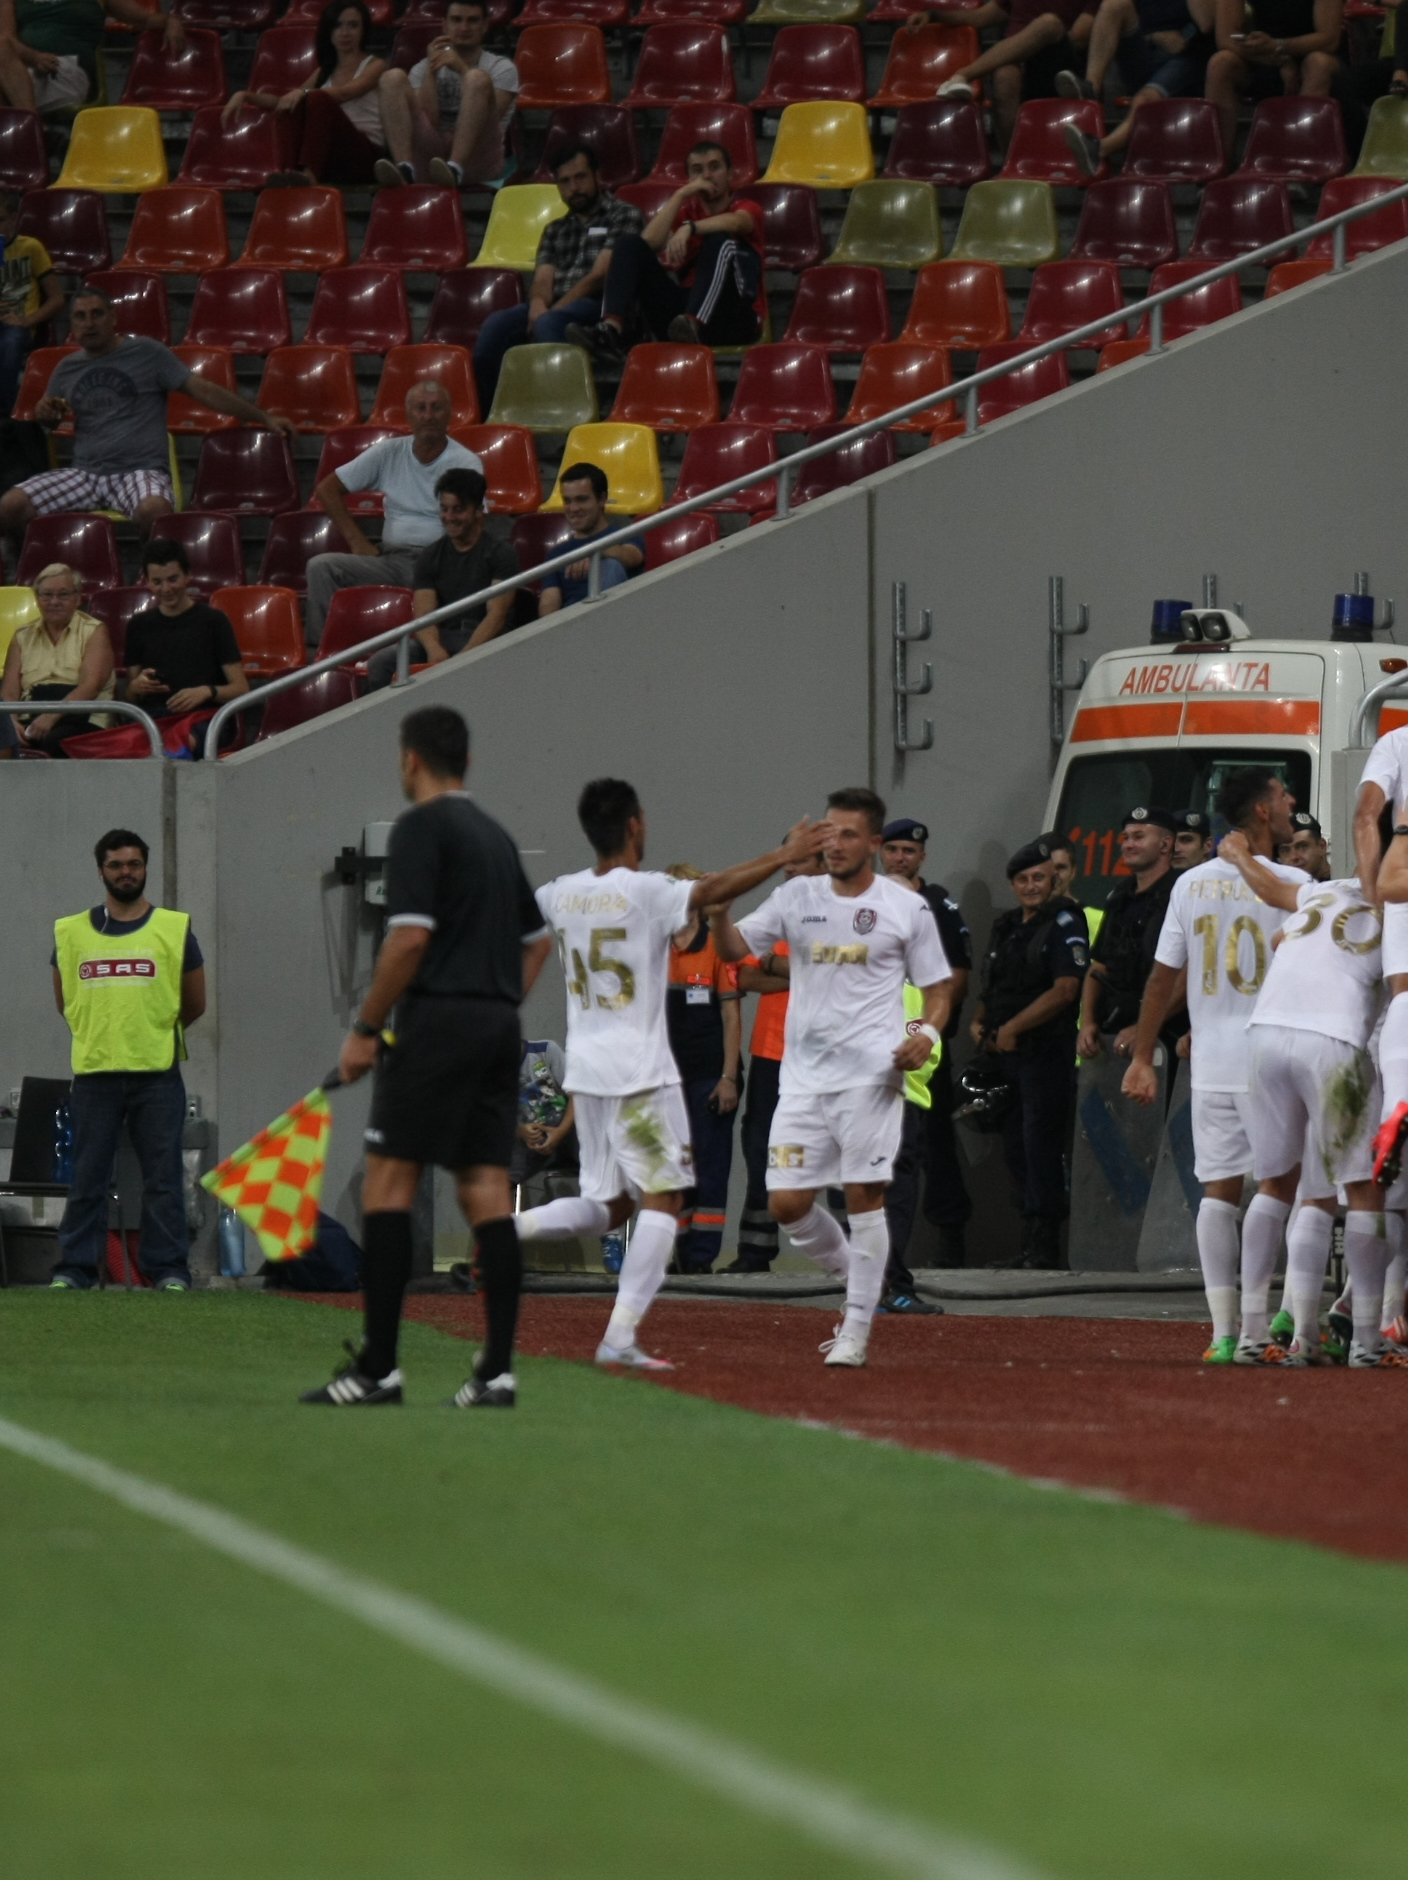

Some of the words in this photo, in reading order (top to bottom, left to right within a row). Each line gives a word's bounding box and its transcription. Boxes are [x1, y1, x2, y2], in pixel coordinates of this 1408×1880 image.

[1118, 662, 1270, 696] AMBULANTA
[1082, 829, 1132, 877] 112
[96, 963, 150, 974] SAS
[557, 928, 634, 1011] 45
[1194, 913, 1266, 996] 10
